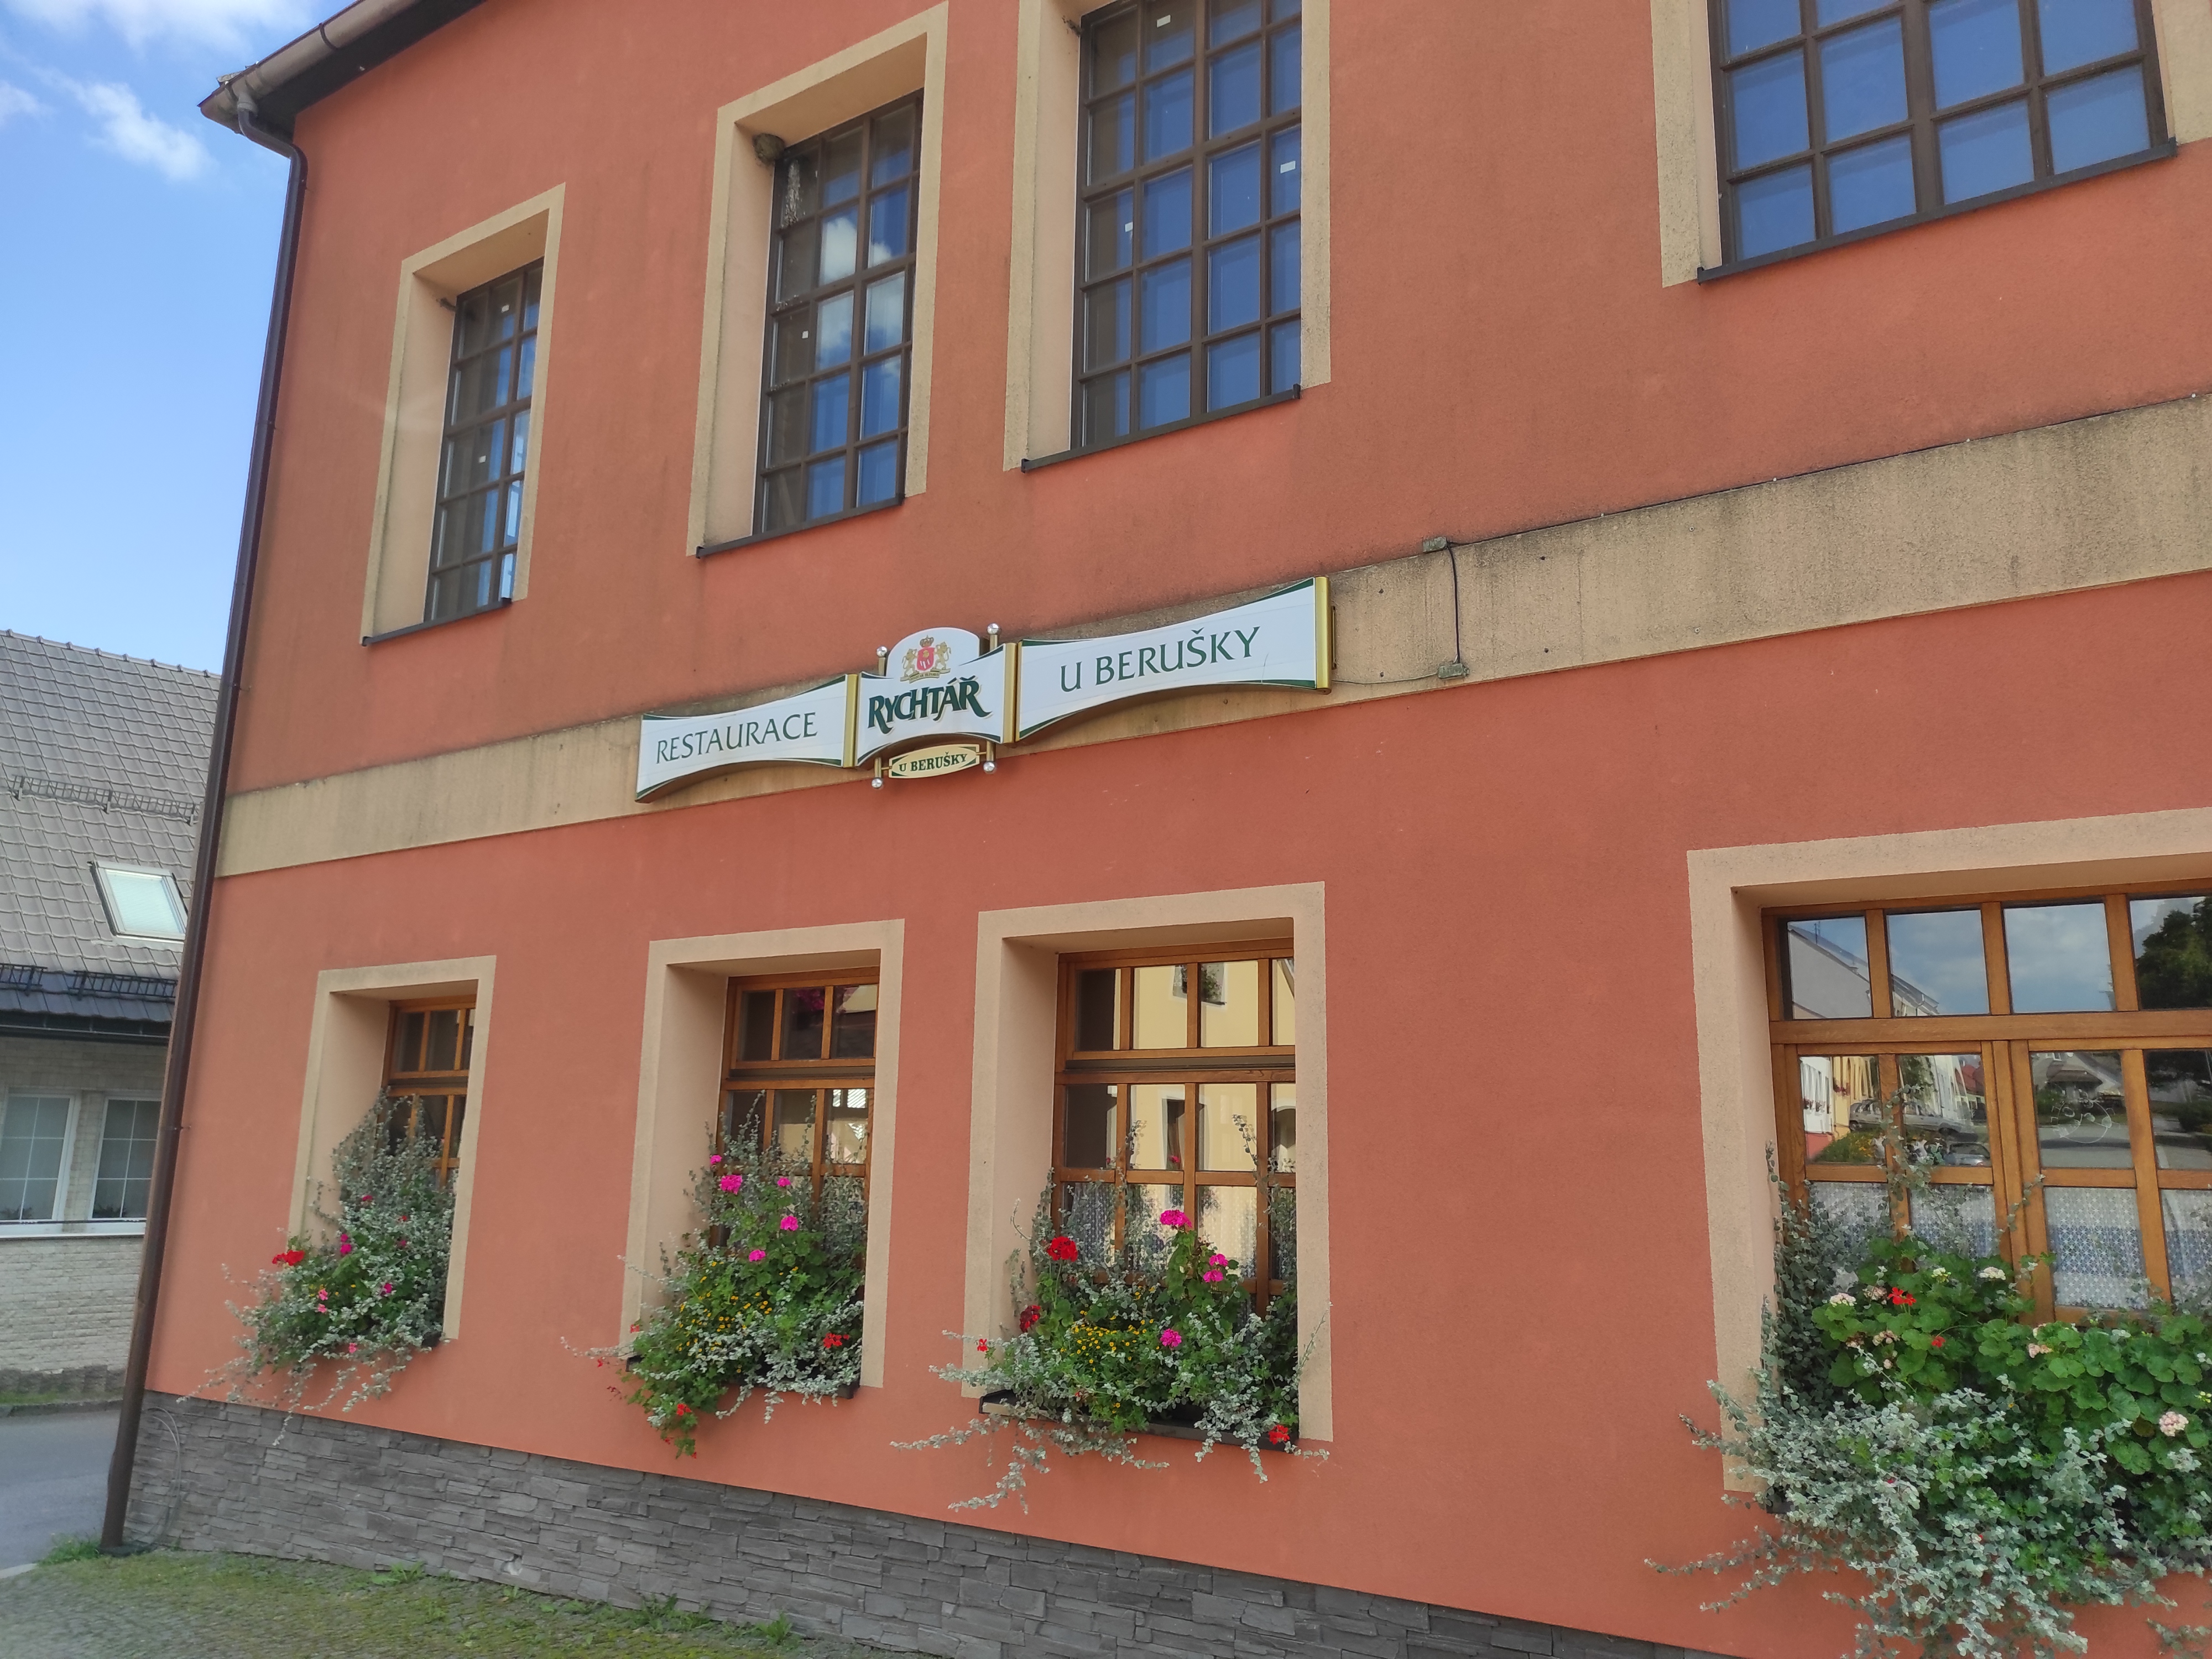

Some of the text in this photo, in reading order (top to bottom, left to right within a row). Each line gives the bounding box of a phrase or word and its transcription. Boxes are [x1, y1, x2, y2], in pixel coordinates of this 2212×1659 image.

[1060, 627, 1260, 692] U BERUŠKY
[868, 675, 993, 734] RYCHTÁŘ
[656, 712, 817, 764] RESTAURACE
[899, 752, 968, 772] U BERUŠKY
